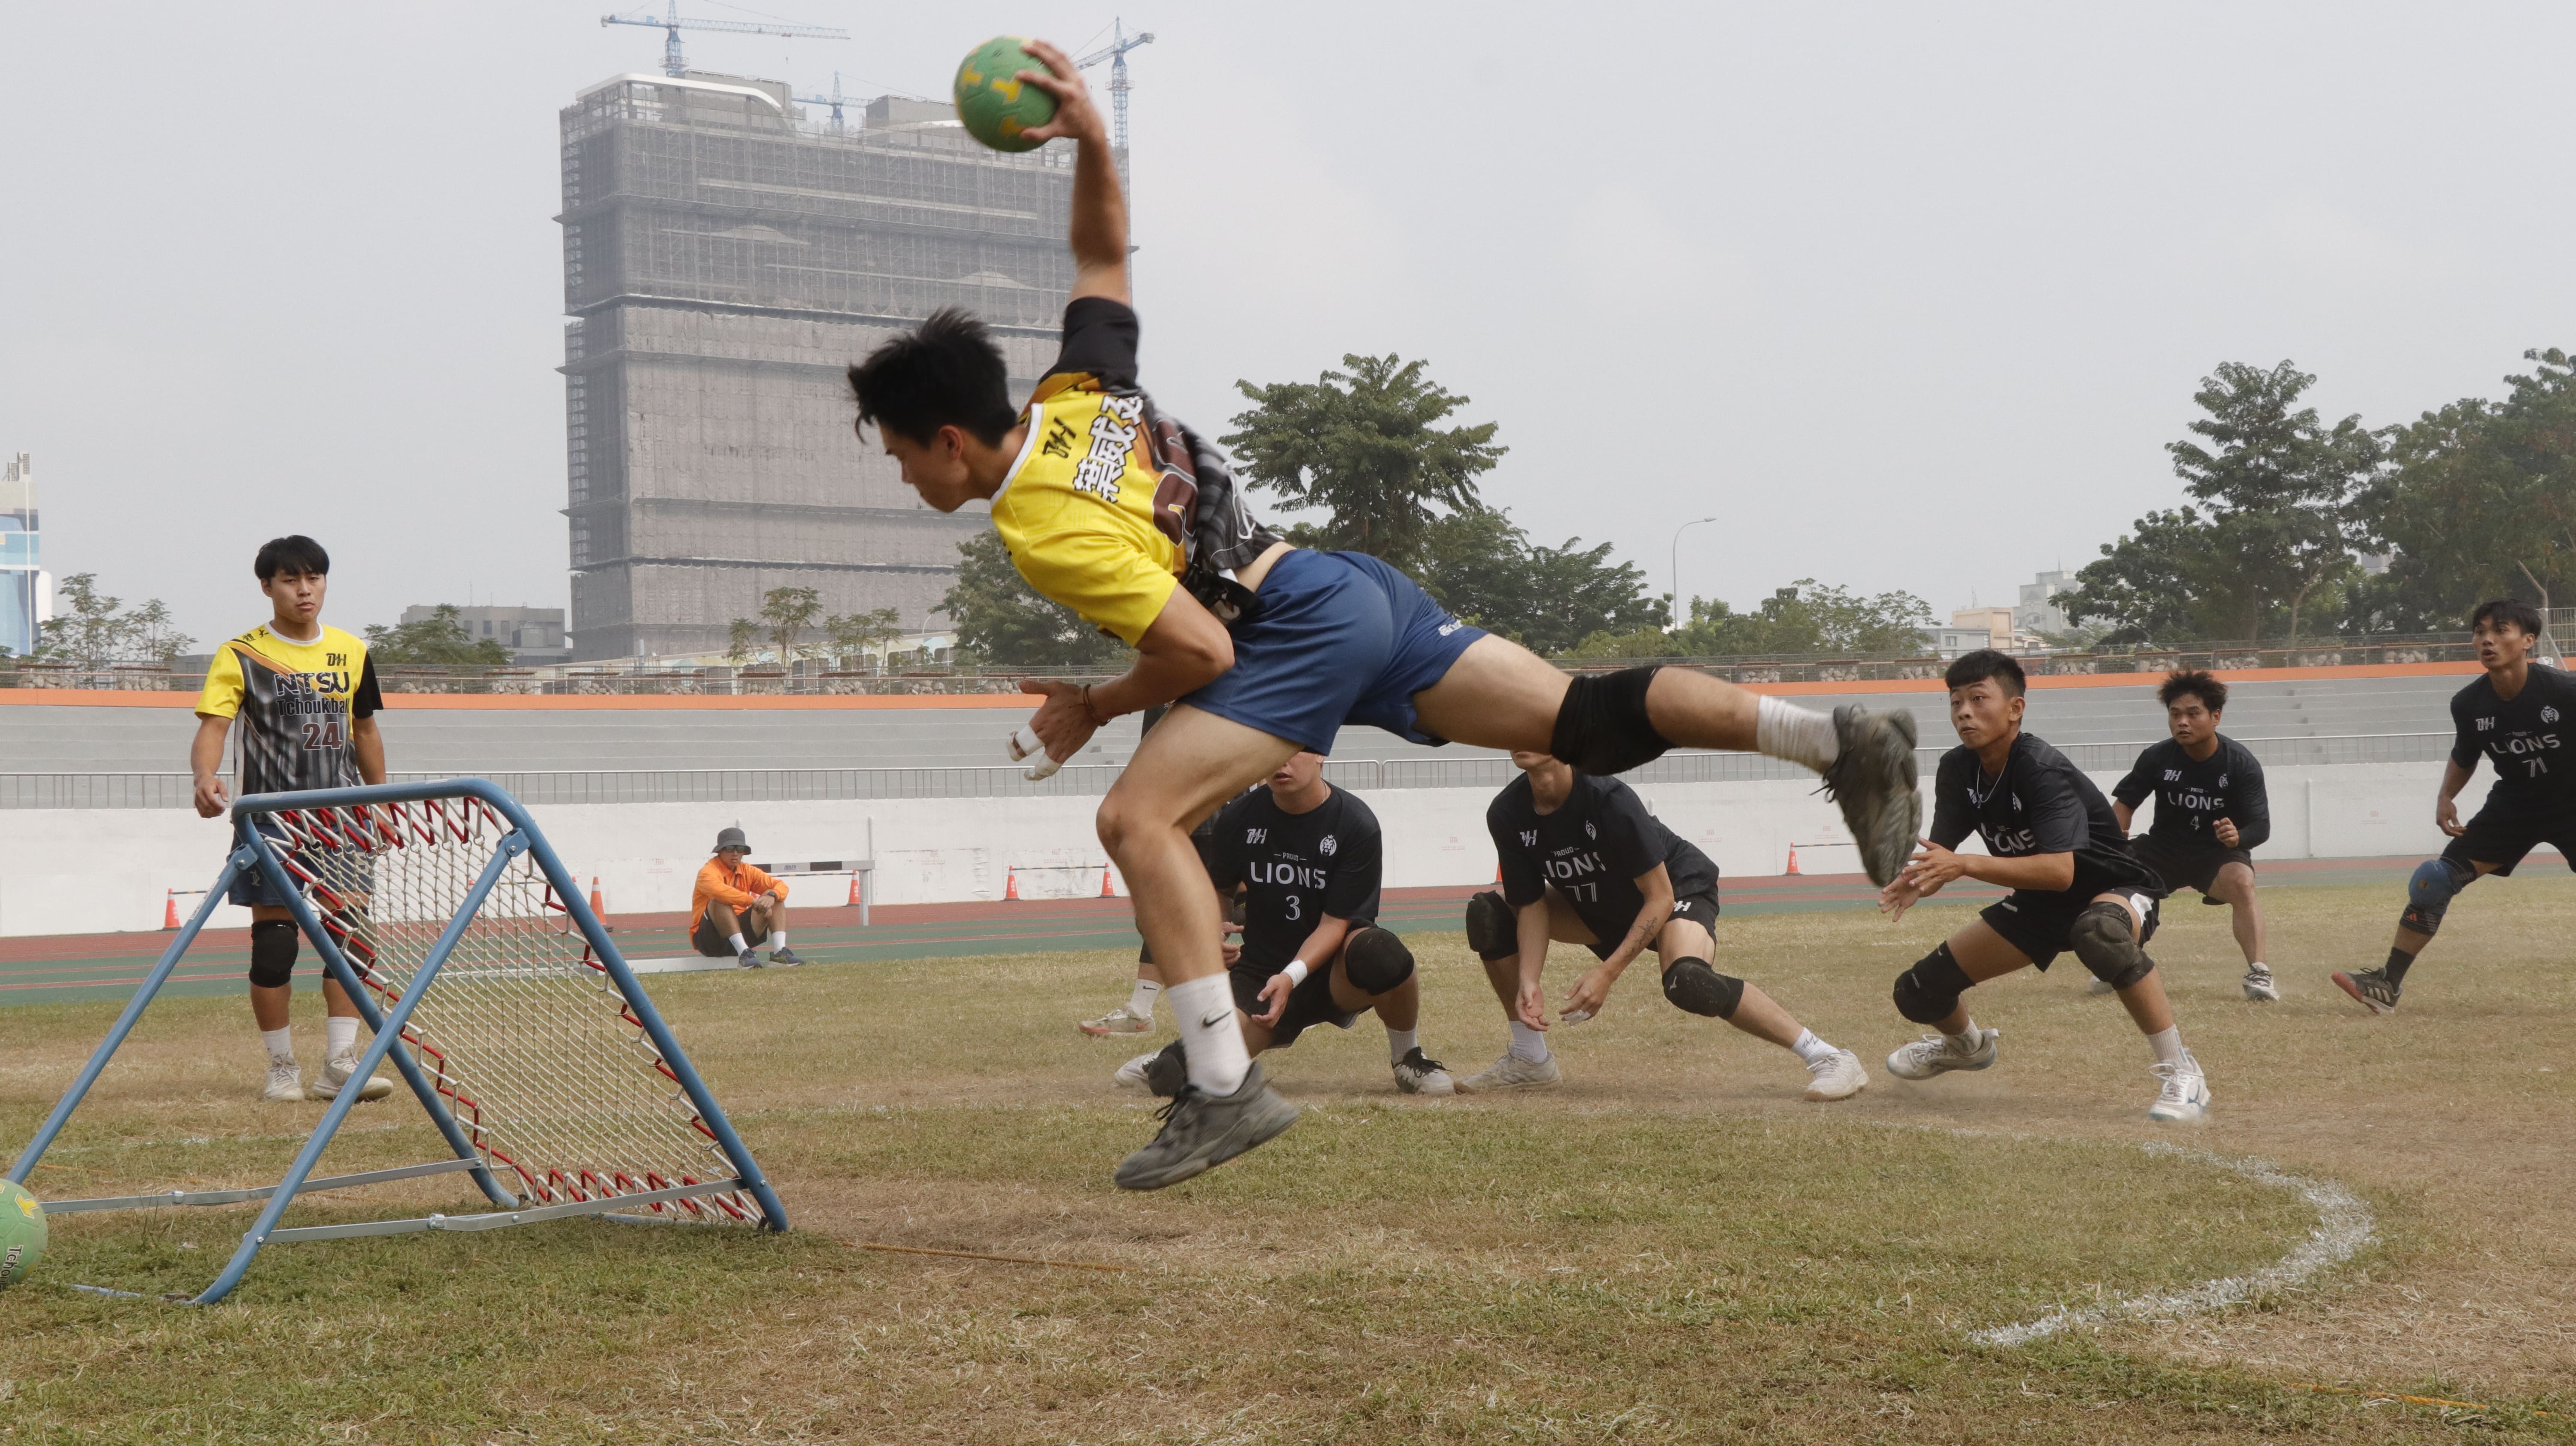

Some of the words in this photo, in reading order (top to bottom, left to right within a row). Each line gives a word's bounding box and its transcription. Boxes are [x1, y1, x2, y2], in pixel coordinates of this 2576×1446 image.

[273, 671, 350, 696] NTSU
[276, 697, 350, 717] Tchoukball
[302, 722, 343, 751] 24
[2521, 756, 2548, 778] 71
[2167, 792, 2224, 811] LIONS
[2190, 815, 2200, 830] 4
[1553, 846, 1574, 857] PROUD
[1250, 862, 1326, 890] LIONS
[1565, 882, 1598, 902] 77
[1285, 895, 1300, 920] 3
